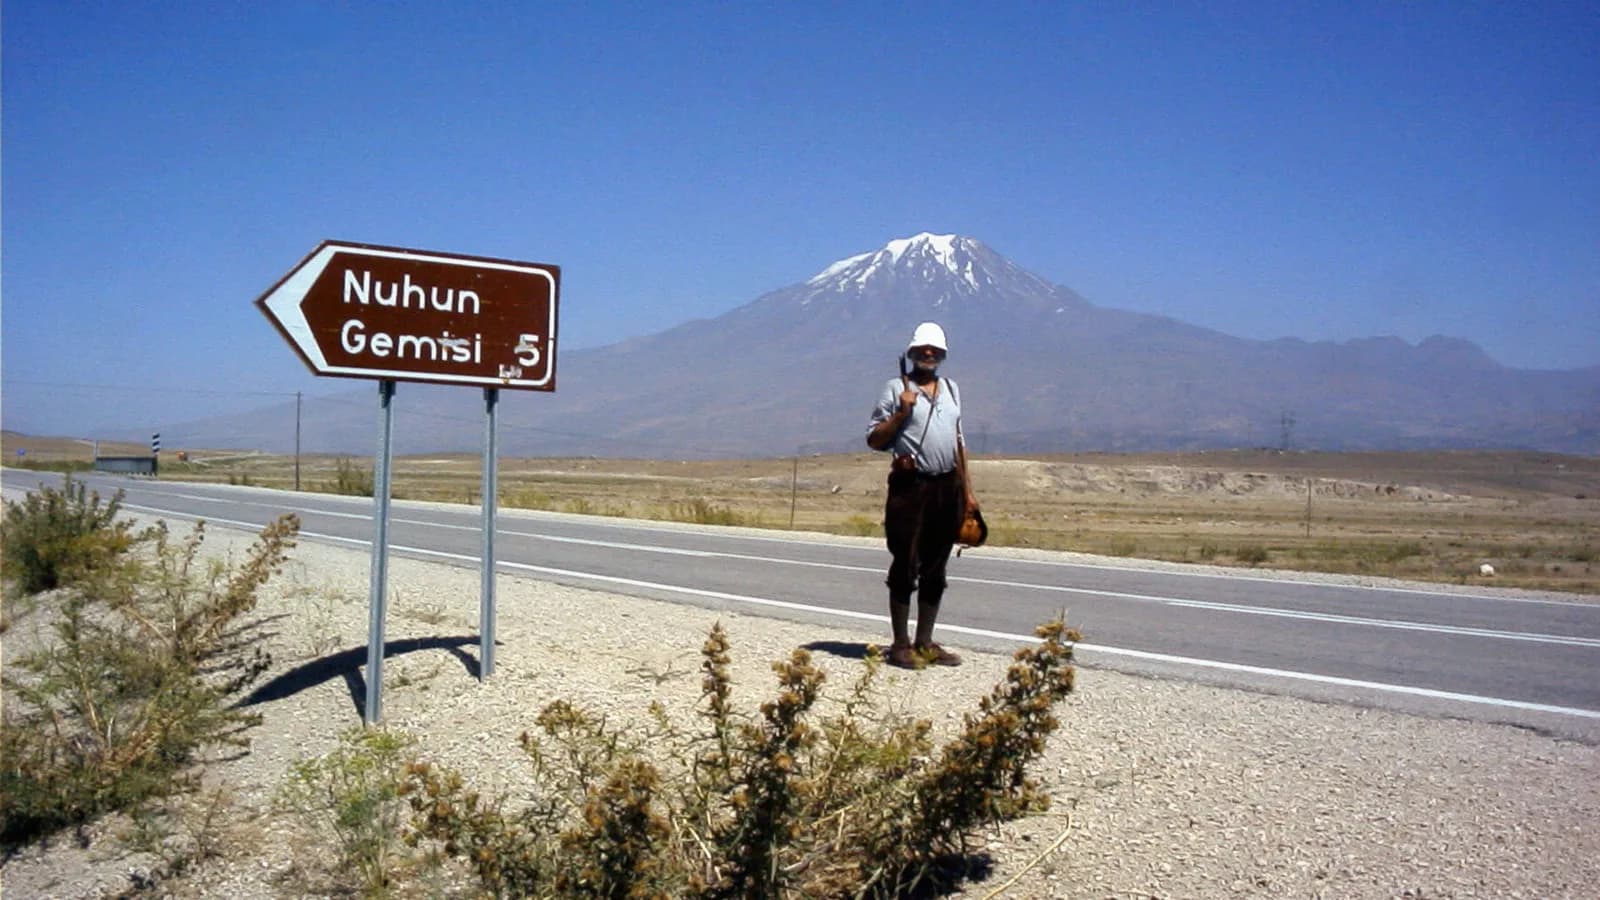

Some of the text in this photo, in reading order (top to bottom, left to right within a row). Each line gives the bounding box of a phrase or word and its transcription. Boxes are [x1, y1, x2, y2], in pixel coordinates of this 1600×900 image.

[343, 269, 480, 314] Nuhun
[341, 319, 540, 367] Gemisi 5
